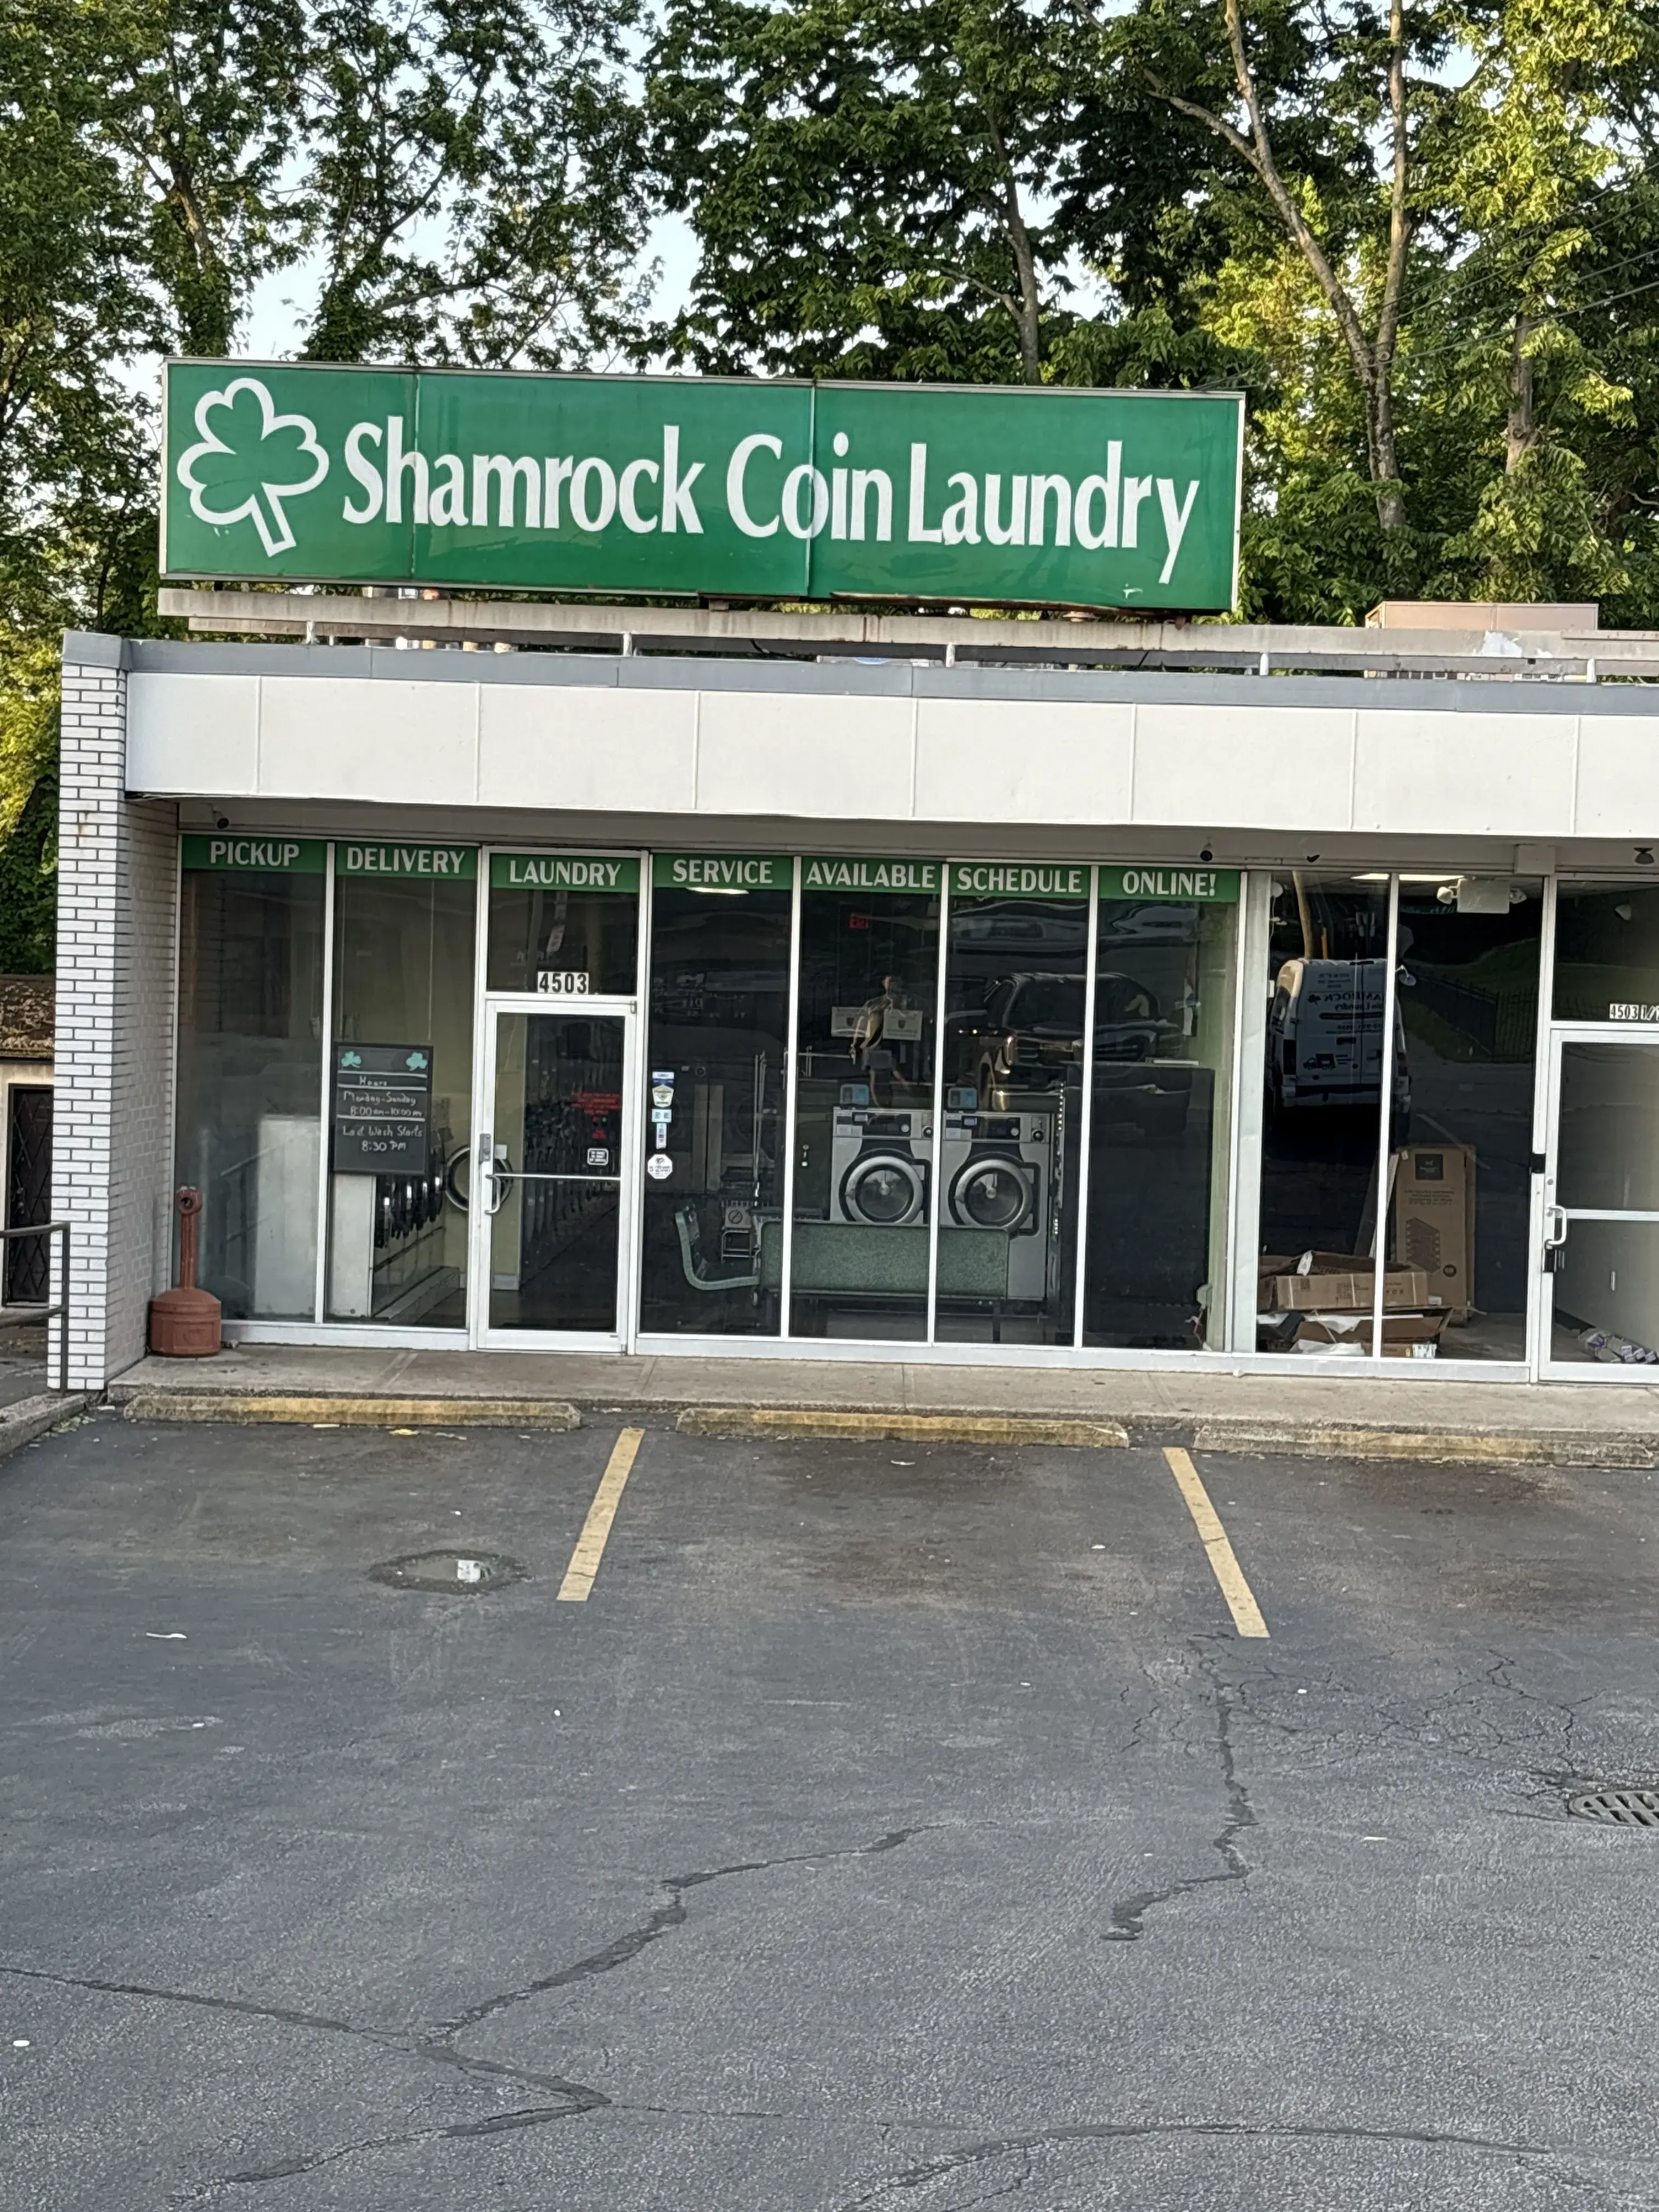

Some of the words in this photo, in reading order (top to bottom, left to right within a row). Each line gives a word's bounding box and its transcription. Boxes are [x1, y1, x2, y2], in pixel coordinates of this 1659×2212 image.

[342, 415, 706, 533] Shamrock
[726, 432, 893, 541] Coin
[908, 440, 1200, 584] Laundry
[210, 841, 300, 867] PICKUP
[347, 847, 464, 873] DELIVERY
[509, 860, 621, 887] LAUNDRY
[672, 859, 773, 884] SERVICE
[806, 862, 936, 888] AVAILABLE
[957, 867, 1082, 894] SCHEDULE
[1122, 871, 1217, 896] ONLINE!
[539, 973, 587, 994] 4503
[1610, 1005, 1638, 1019] 4503
[368, 1124, 393, 1137] Wash
[362, 1139, 387, 1152] 8:30
[389, 1139, 407, 1151] PM
